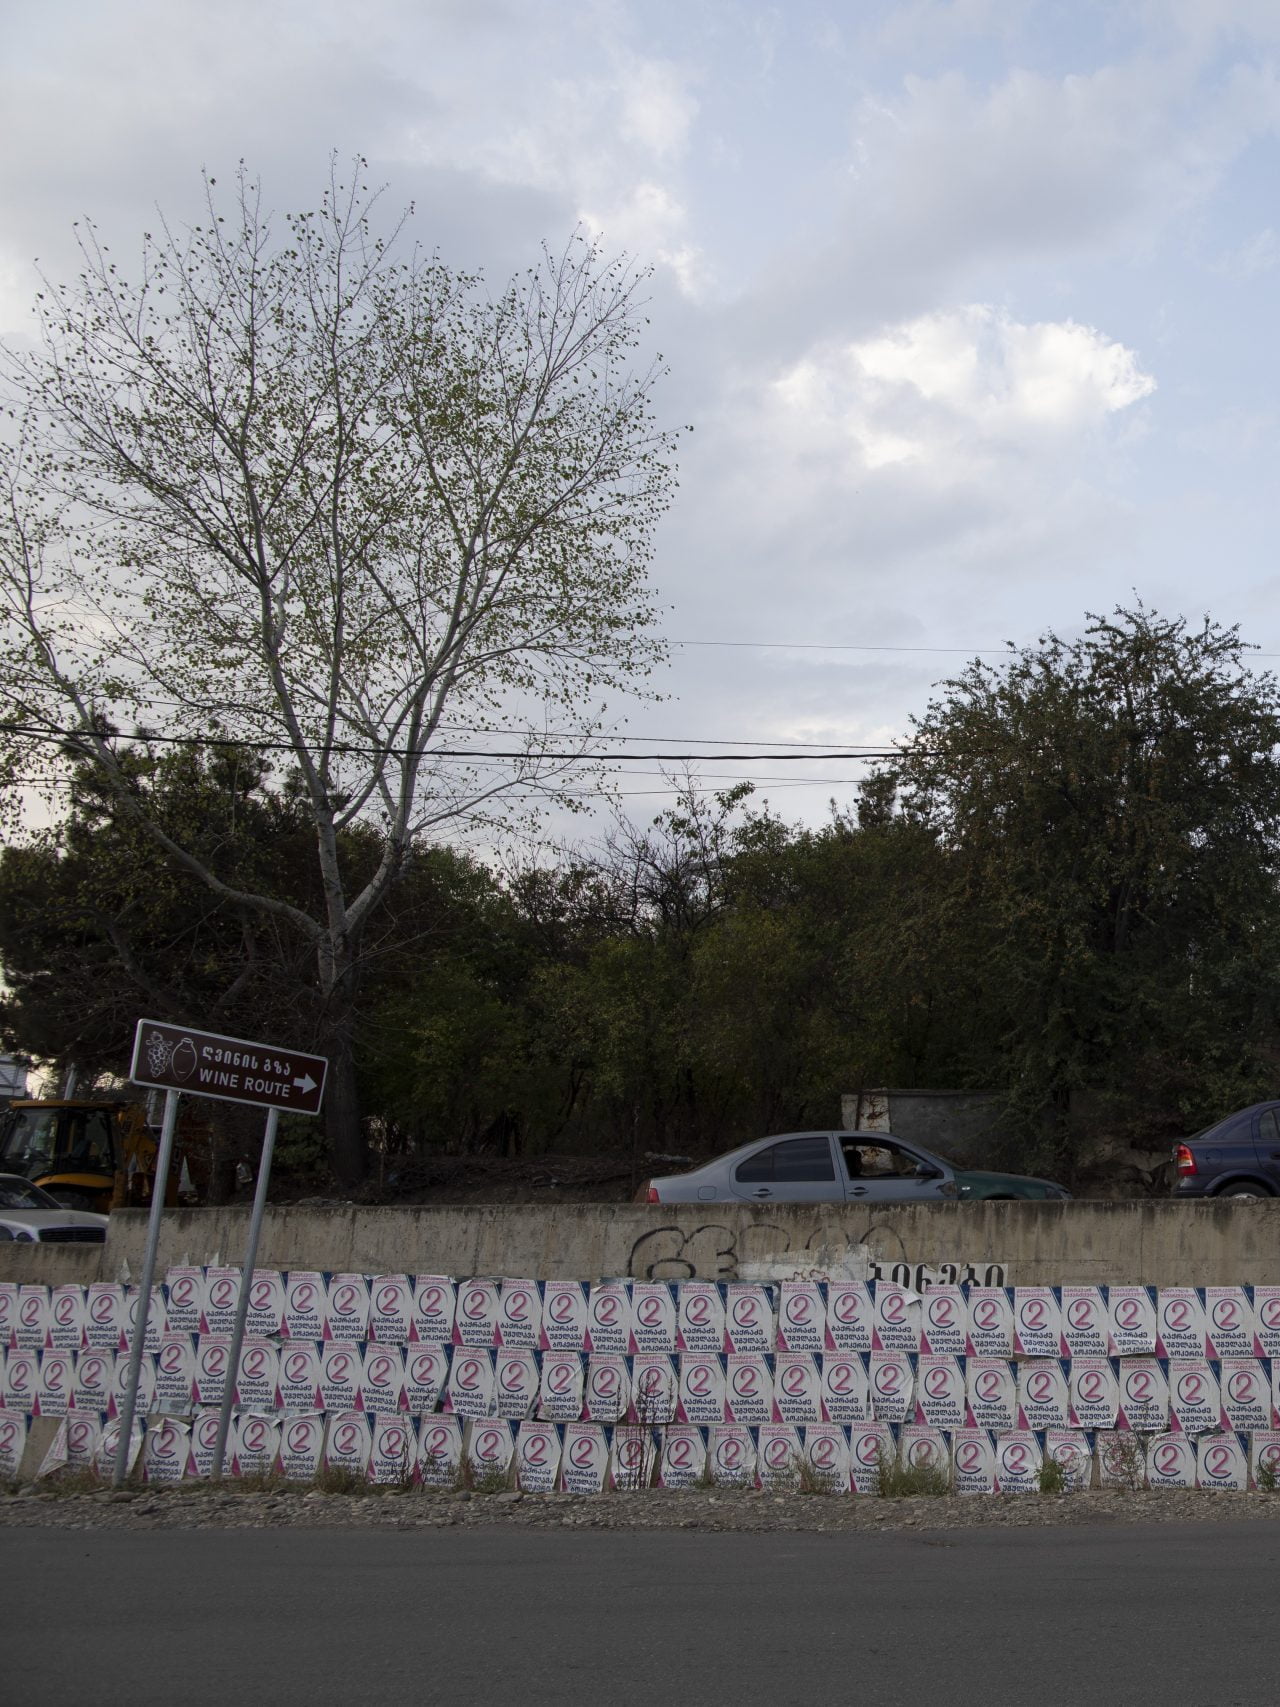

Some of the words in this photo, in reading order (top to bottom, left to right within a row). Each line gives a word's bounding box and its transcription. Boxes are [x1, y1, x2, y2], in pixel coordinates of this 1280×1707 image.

[202, 1046, 258, 1069] ღვინის
[264, 1058, 291, 1076] გზა
[199, 1067, 239, 1088] WINE
[244, 1077, 291, 1098] ROUTE
[297, 1286, 312, 1309] 2
[382, 1288, 398, 1311] 2
[556, 1296, 571, 1319] 2
[692, 1298, 708, 1321] 2
[793, 1297, 808, 1321] 2
[841, 1295, 857, 1319] 2
[644, 1299, 659, 1323] 2
[936, 1300, 951, 1324] 2
[980, 1302, 996, 1326] 2
[1075, 1302, 1090, 1326] 2
[1171, 1302, 1187, 1327] 2
[1220, 1302, 1235, 1326] 2
[373, 1359, 390, 1383] 2
[693, 1368, 709, 1392] 2
[740, 1369, 755, 1393] 2
[788, 1368, 804, 1392] 2
[834, 1366, 850, 1391] 2
[931, 1370, 947, 1394] 2
[982, 1373, 998, 1398] 2
[1236, 1374, 1251, 1399] 2
[575, 1439, 593, 1464] 2
[1161, 1446, 1178, 1472] 2
